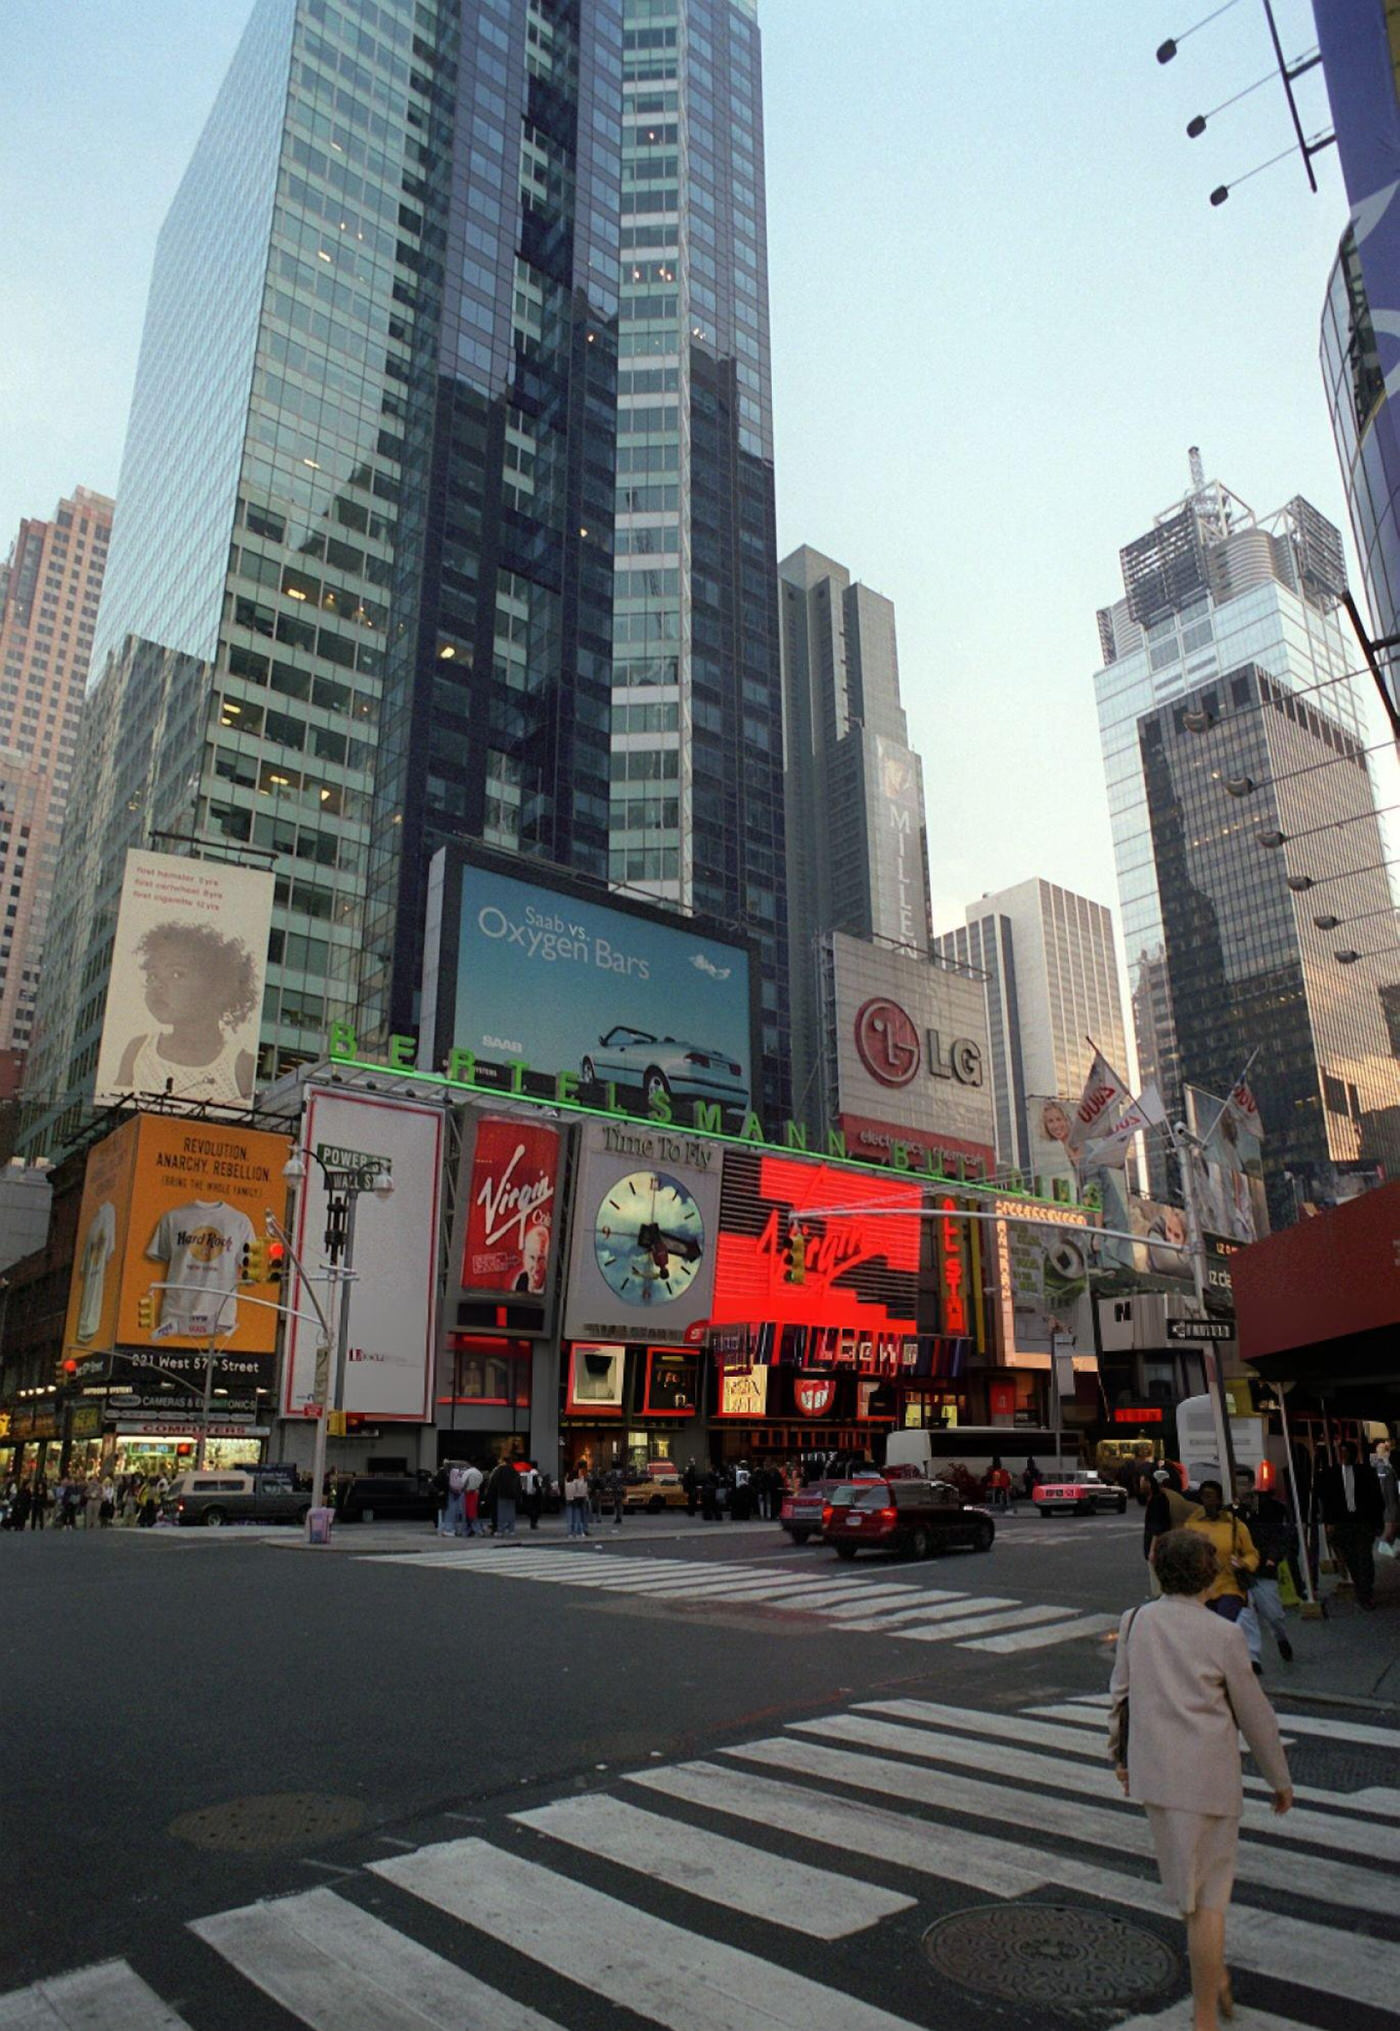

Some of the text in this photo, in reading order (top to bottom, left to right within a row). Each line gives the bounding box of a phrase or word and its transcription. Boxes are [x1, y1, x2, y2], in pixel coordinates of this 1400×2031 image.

[525, 906, 591, 942] Saab vs.
[478, 906, 650, 980] Oxygen Bars
[482, 1034, 523, 1054] SAAB
[926, 1028, 983, 1087] LG
[329, 1021, 847, 1159] BERTELSMANN
[183, 1137, 249, 1161] REVOLUTION.
[323, 1147, 368, 1169] POWER
[602, 1126, 714, 1169] Time To Fly
[155, 1152, 273, 1182] ANARCHY. REBELLION.
[477, 1144, 554, 1250] Virgin
[159, 1355, 190, 1370] West
[221, 1359, 260, 1374] Street
